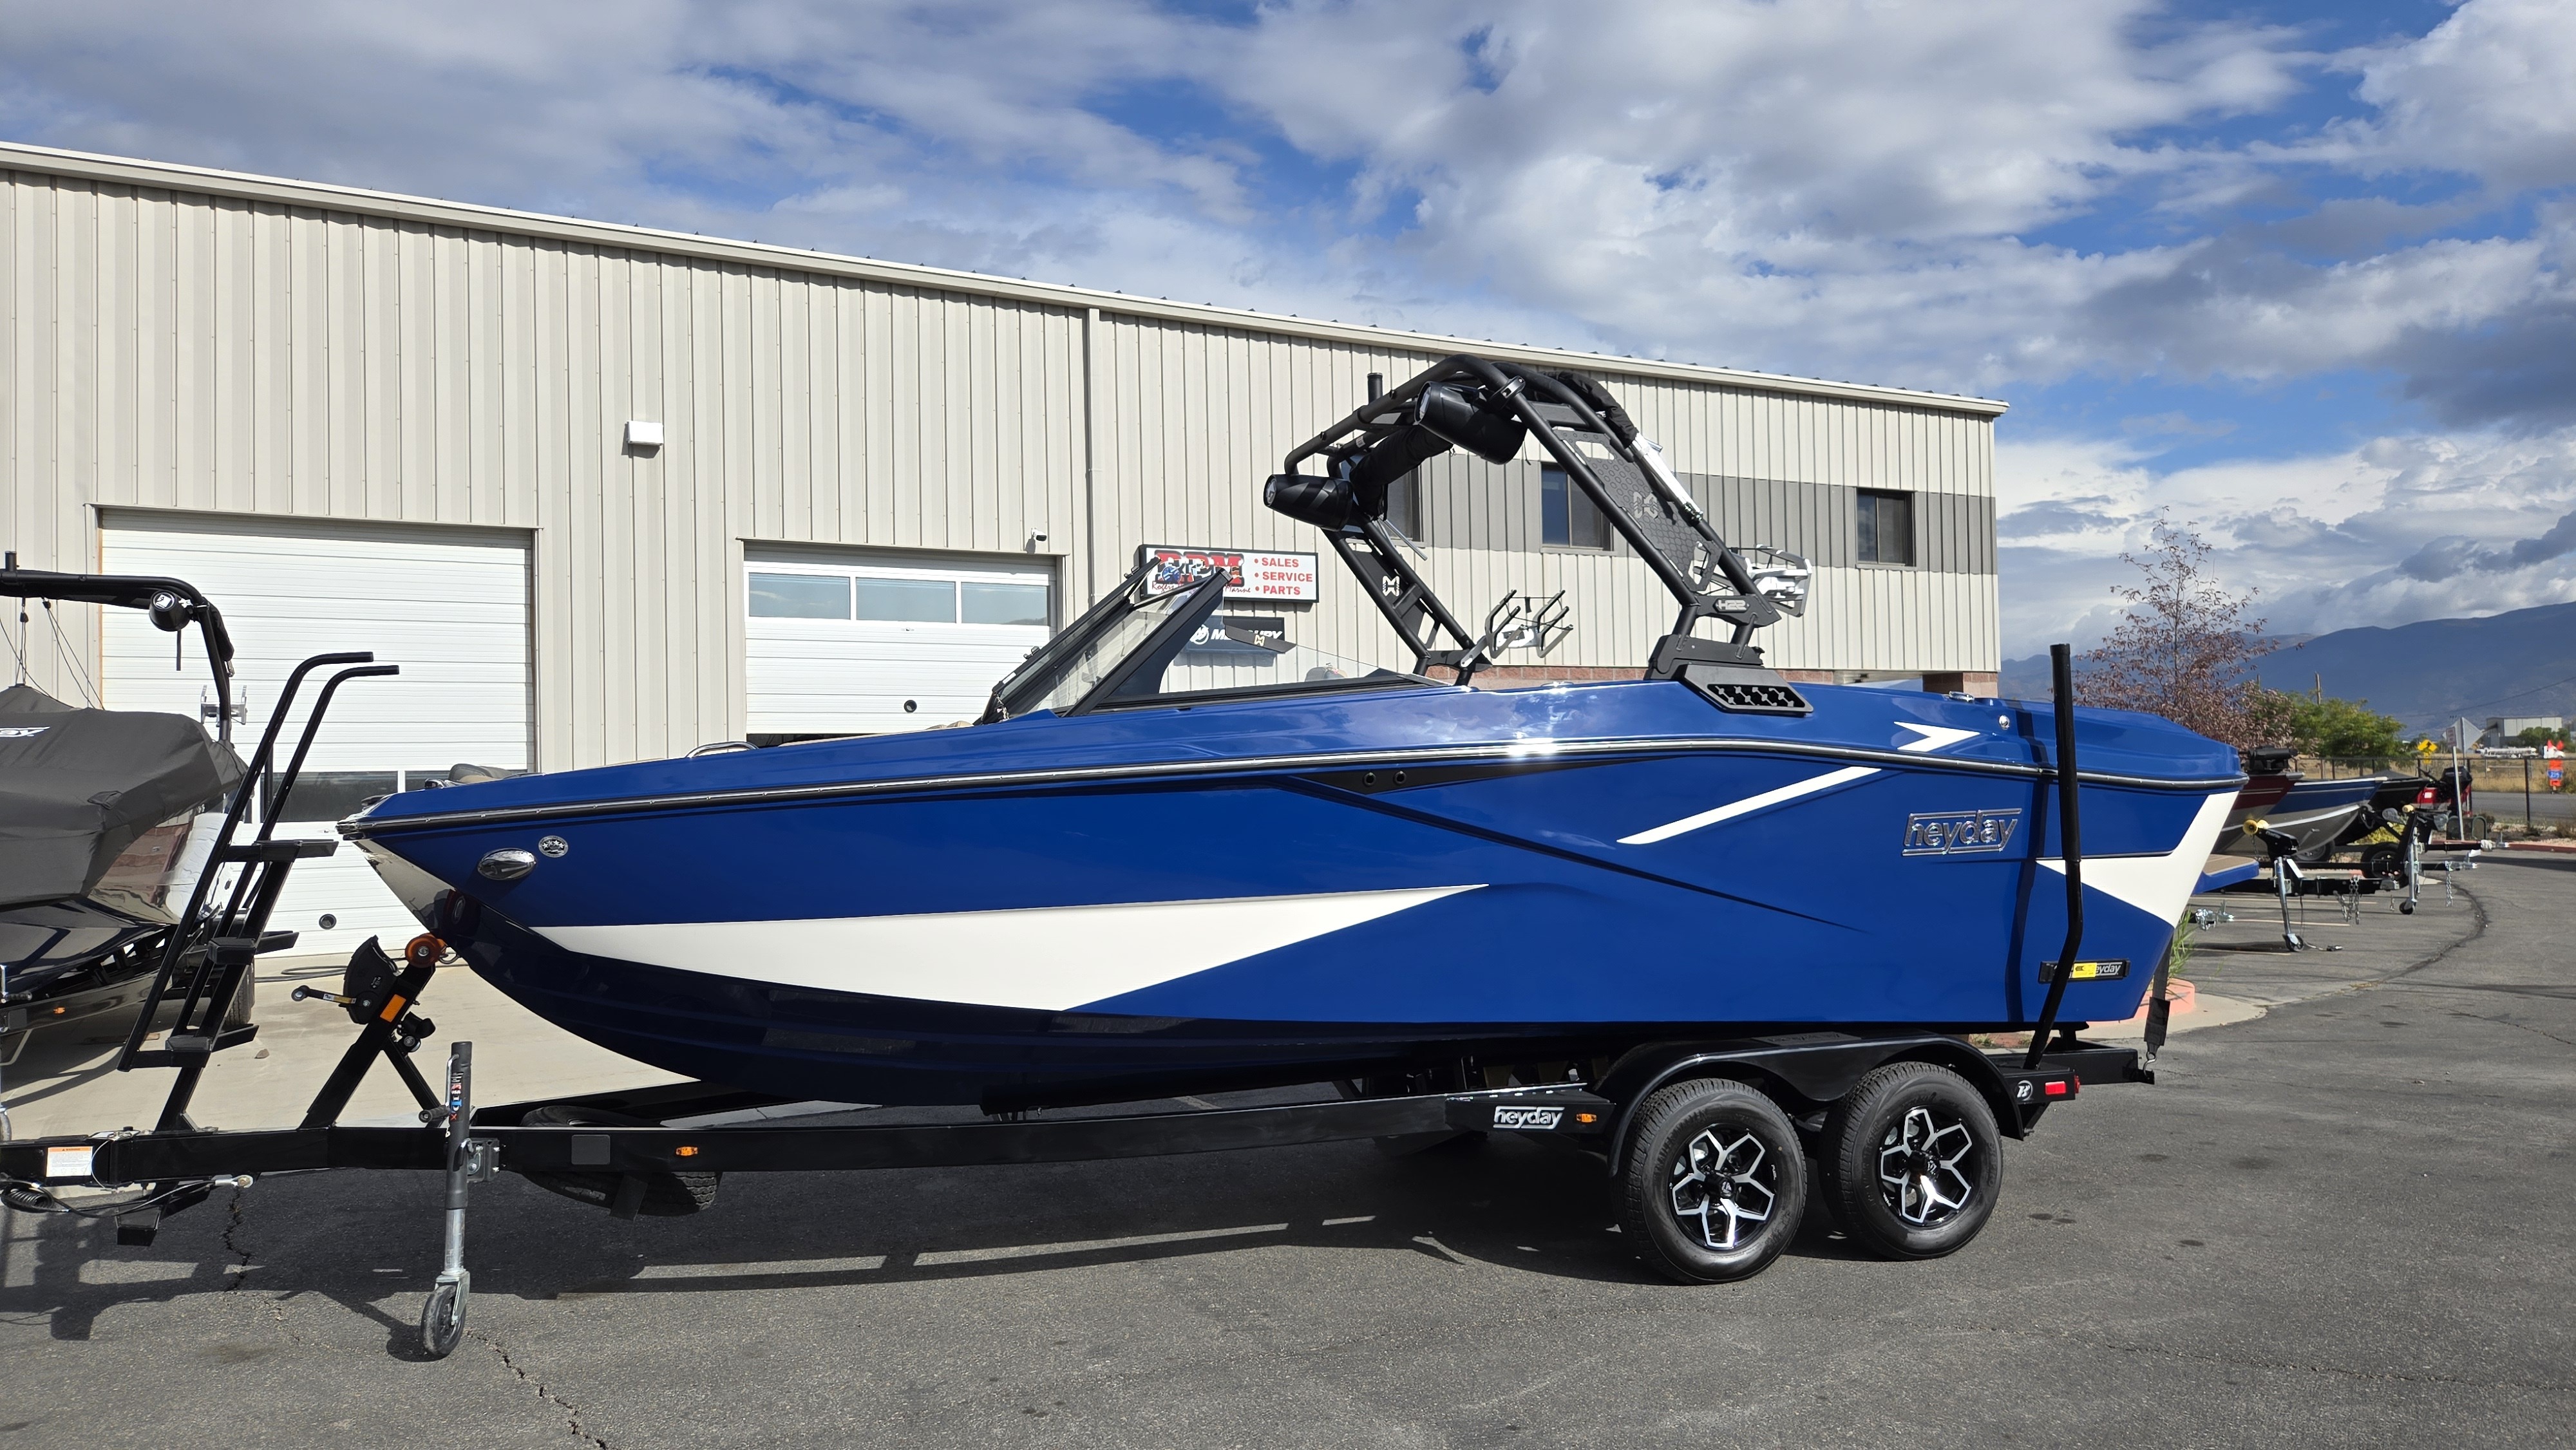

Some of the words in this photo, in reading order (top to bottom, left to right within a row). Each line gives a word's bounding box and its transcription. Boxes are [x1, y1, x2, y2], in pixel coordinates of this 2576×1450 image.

[1262, 557, 1300, 568] SALES
[1262, 571, 1313, 583] SERVICE
[1225, 583, 1251, 594] Marine
[1263, 585, 1301, 596] PARTS
[1718, 599, 1747, 610] H22
[1902, 808, 2022, 856] heyday
[2095, 961, 2123, 976] eyday
[1493, 1106, 1565, 1130] heyday
